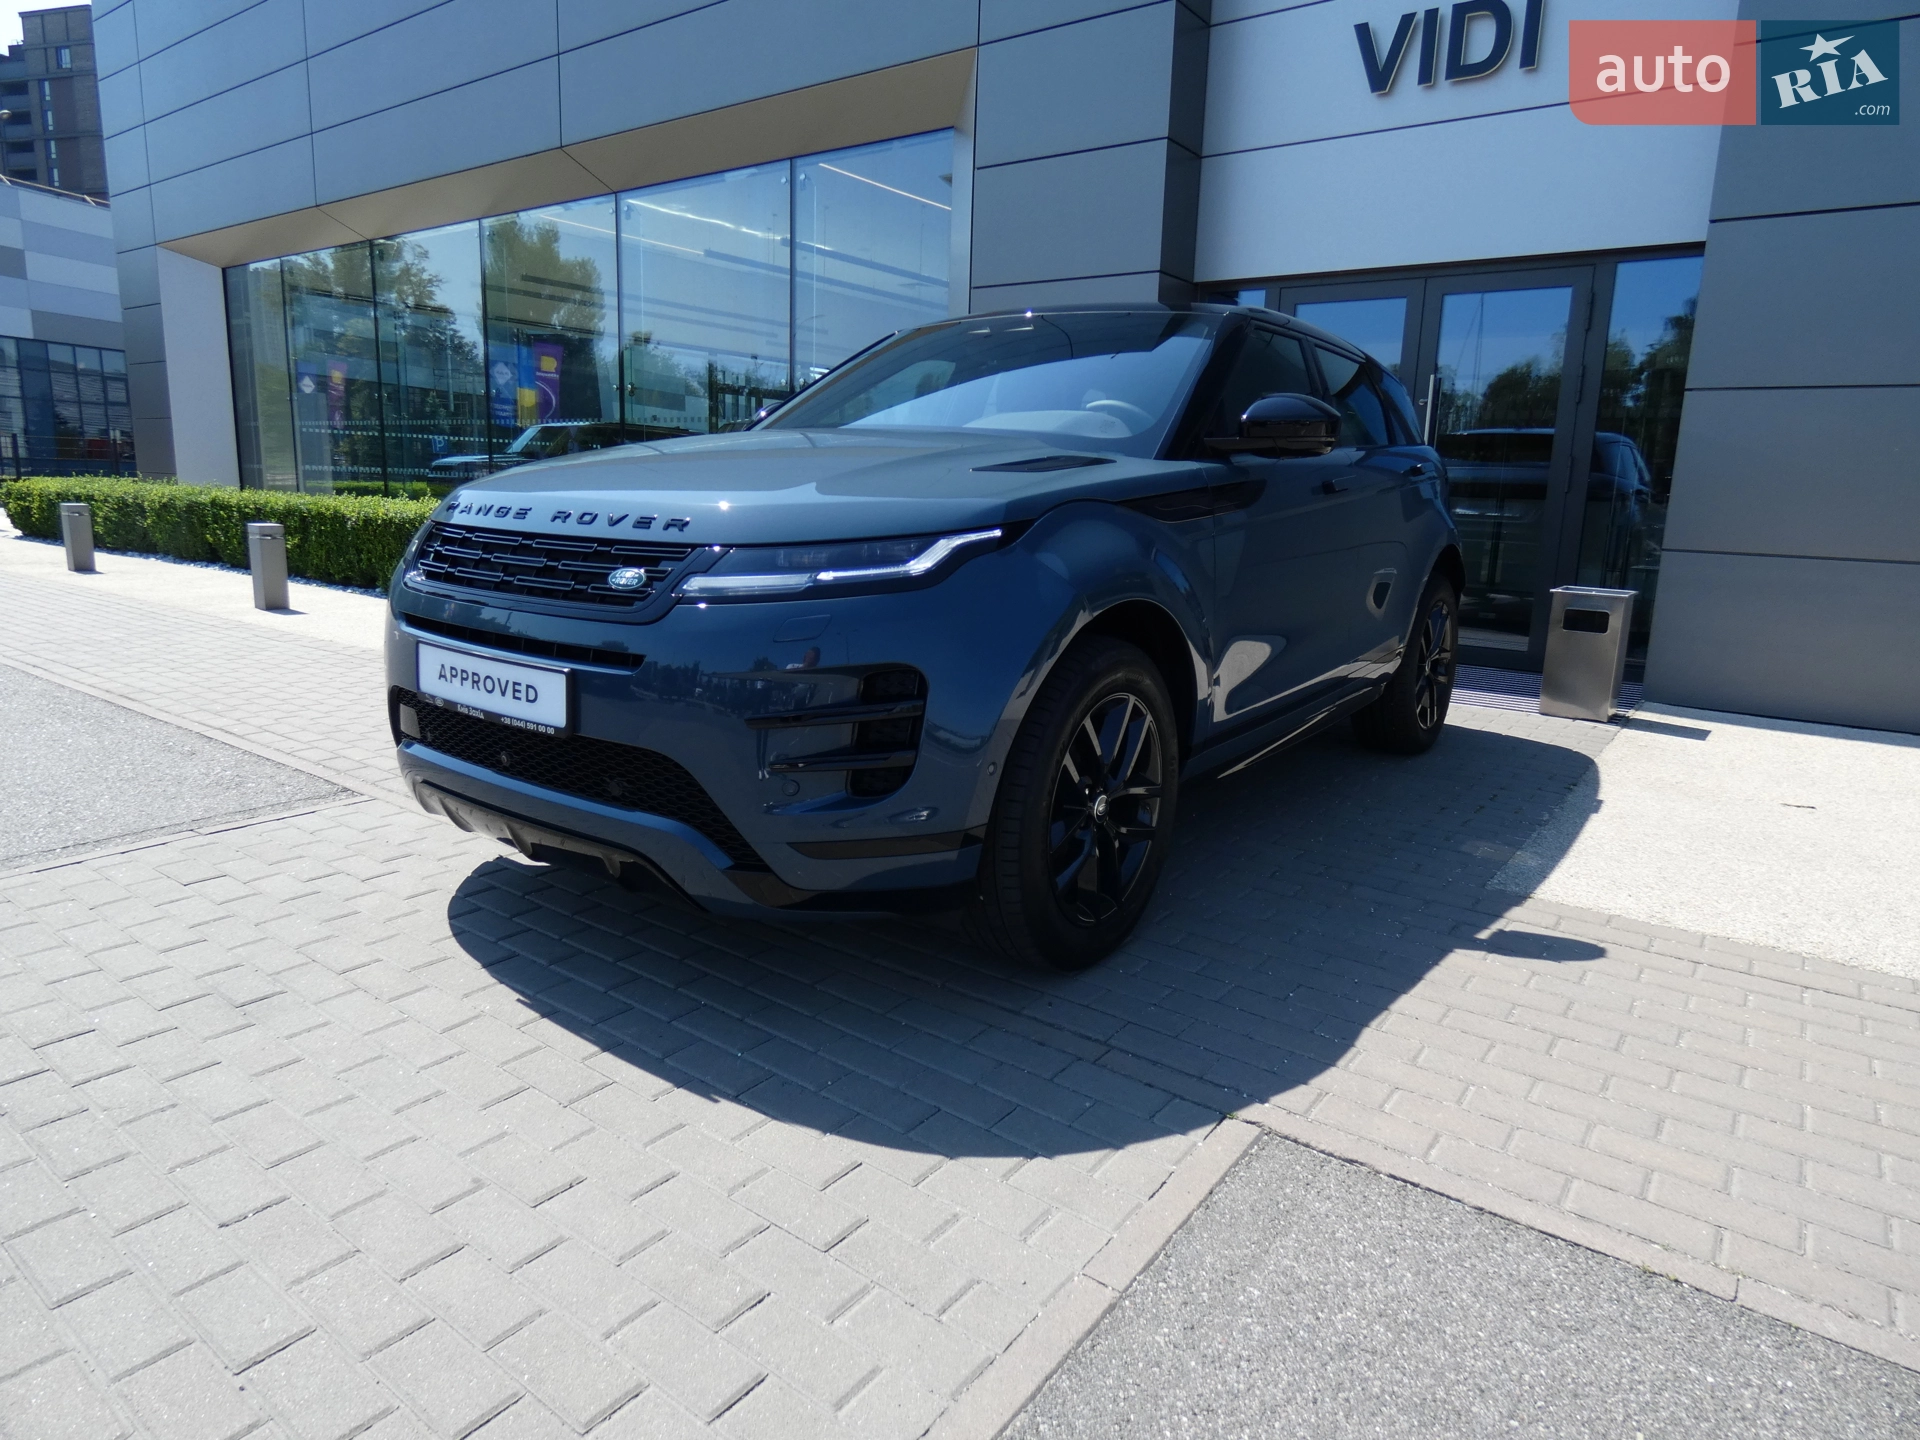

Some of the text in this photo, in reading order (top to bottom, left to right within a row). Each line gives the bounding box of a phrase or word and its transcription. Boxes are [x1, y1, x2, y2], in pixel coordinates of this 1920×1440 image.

[1353, 0, 1545, 94] VIDI
[446, 501, 691, 532] RANGE ROVER
[615, 570, 635, 578] LAD
[438, 663, 539, 703] APPROVED
[501, 717, 555, 735] +38 (044) 591 00 00
